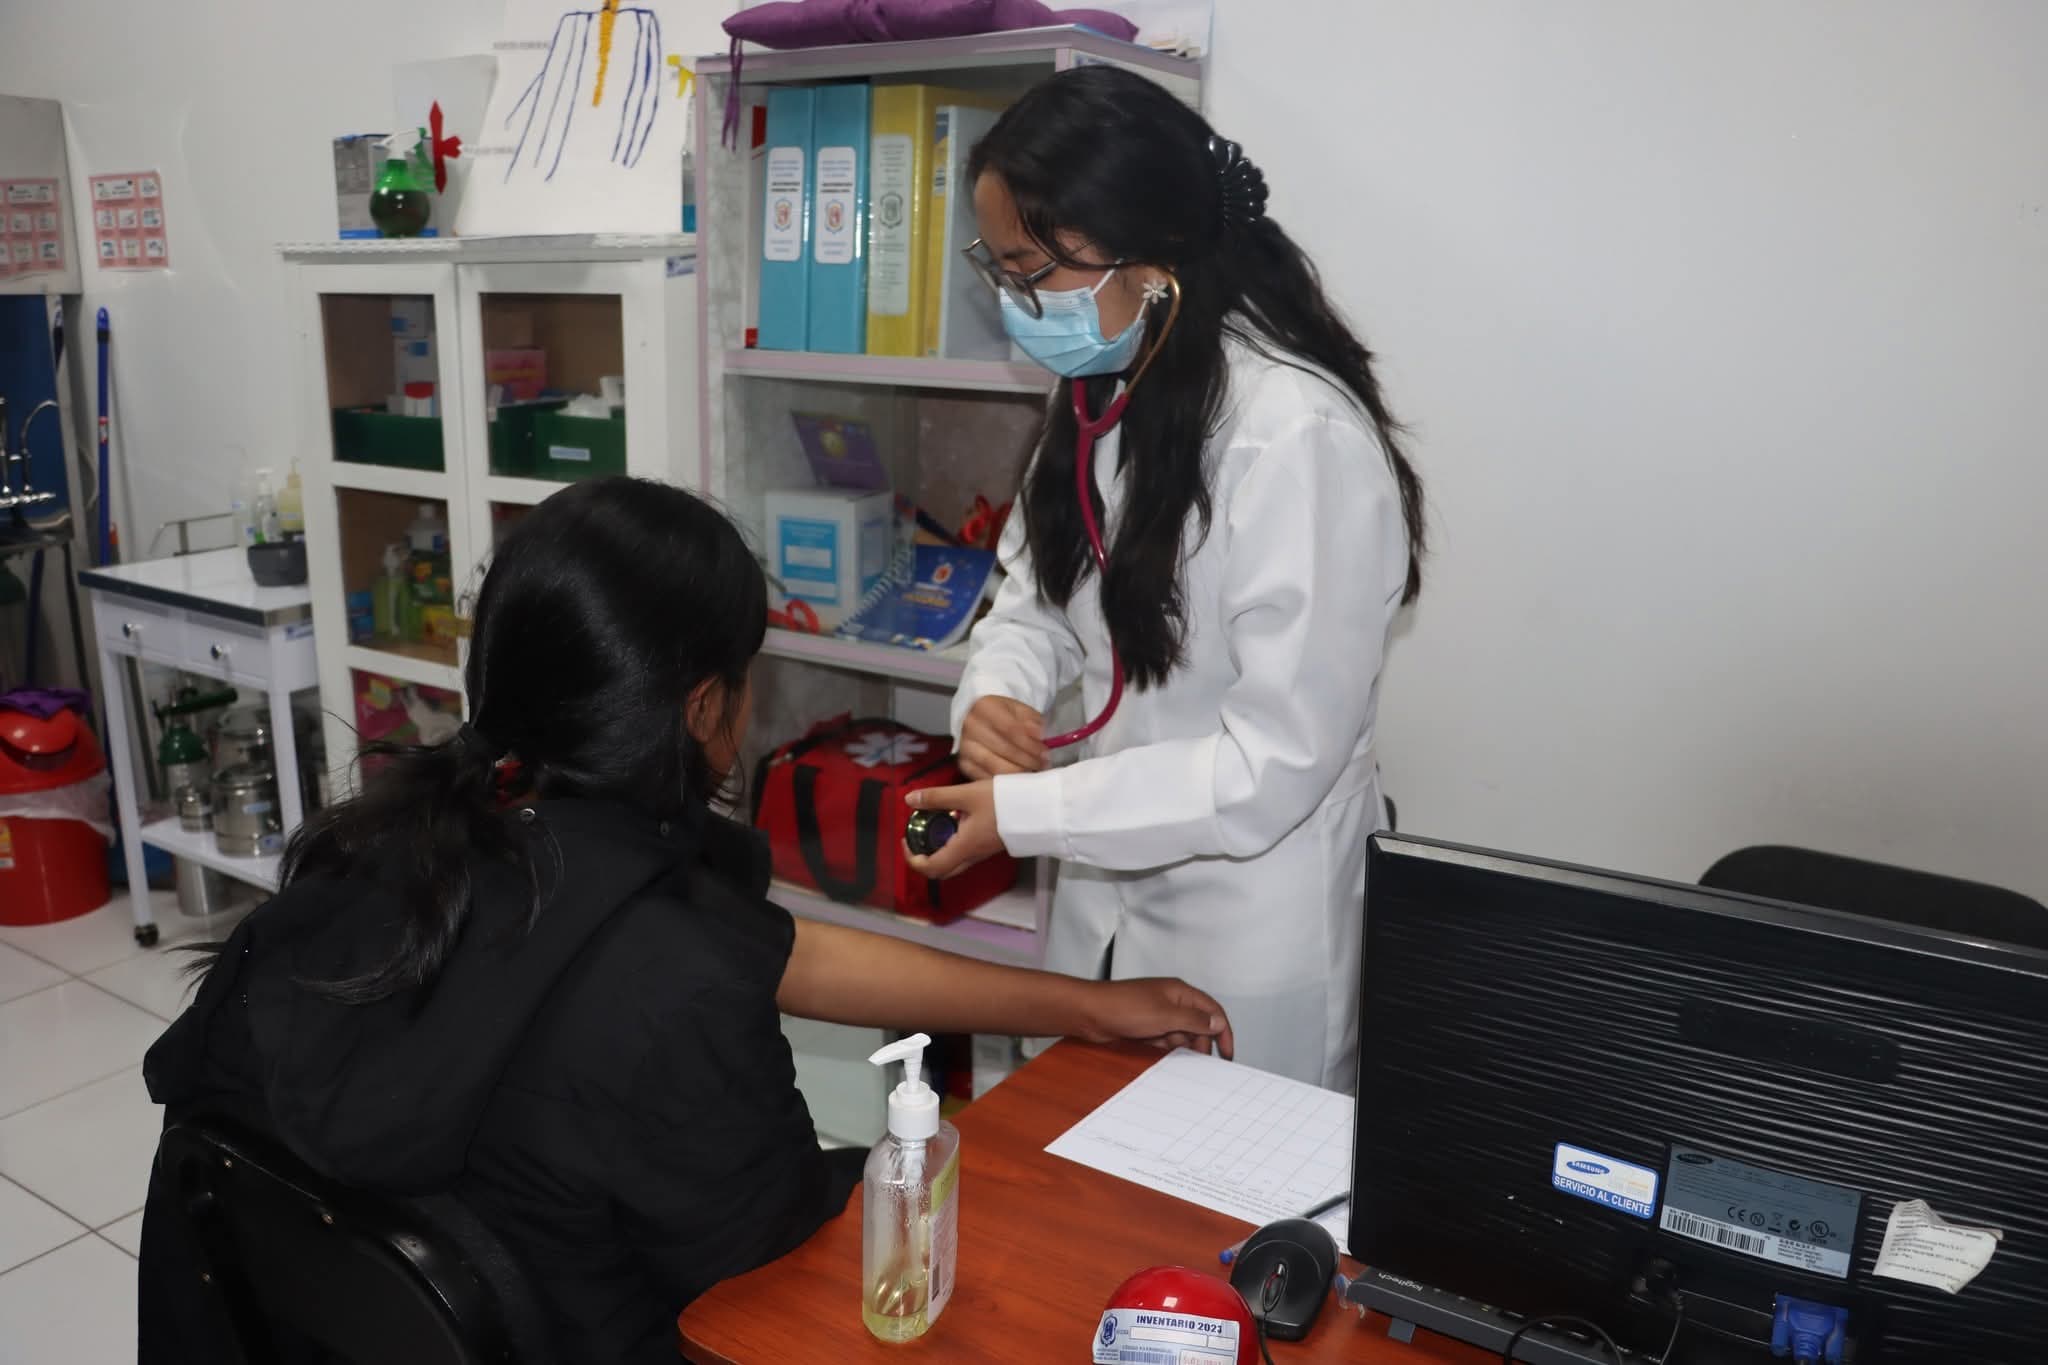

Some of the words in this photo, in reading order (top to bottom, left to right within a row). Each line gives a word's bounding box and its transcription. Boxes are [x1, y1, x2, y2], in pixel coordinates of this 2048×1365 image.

[1554, 1175, 1596, 1197] SERVICIO
[1597, 1190, 1610, 1203] AL
[1611, 1194, 1651, 1216] CLIENTE
[1378, 1272, 1424, 1291] logitech
[1136, 1314, 1196, 1330] INVENTARIO
